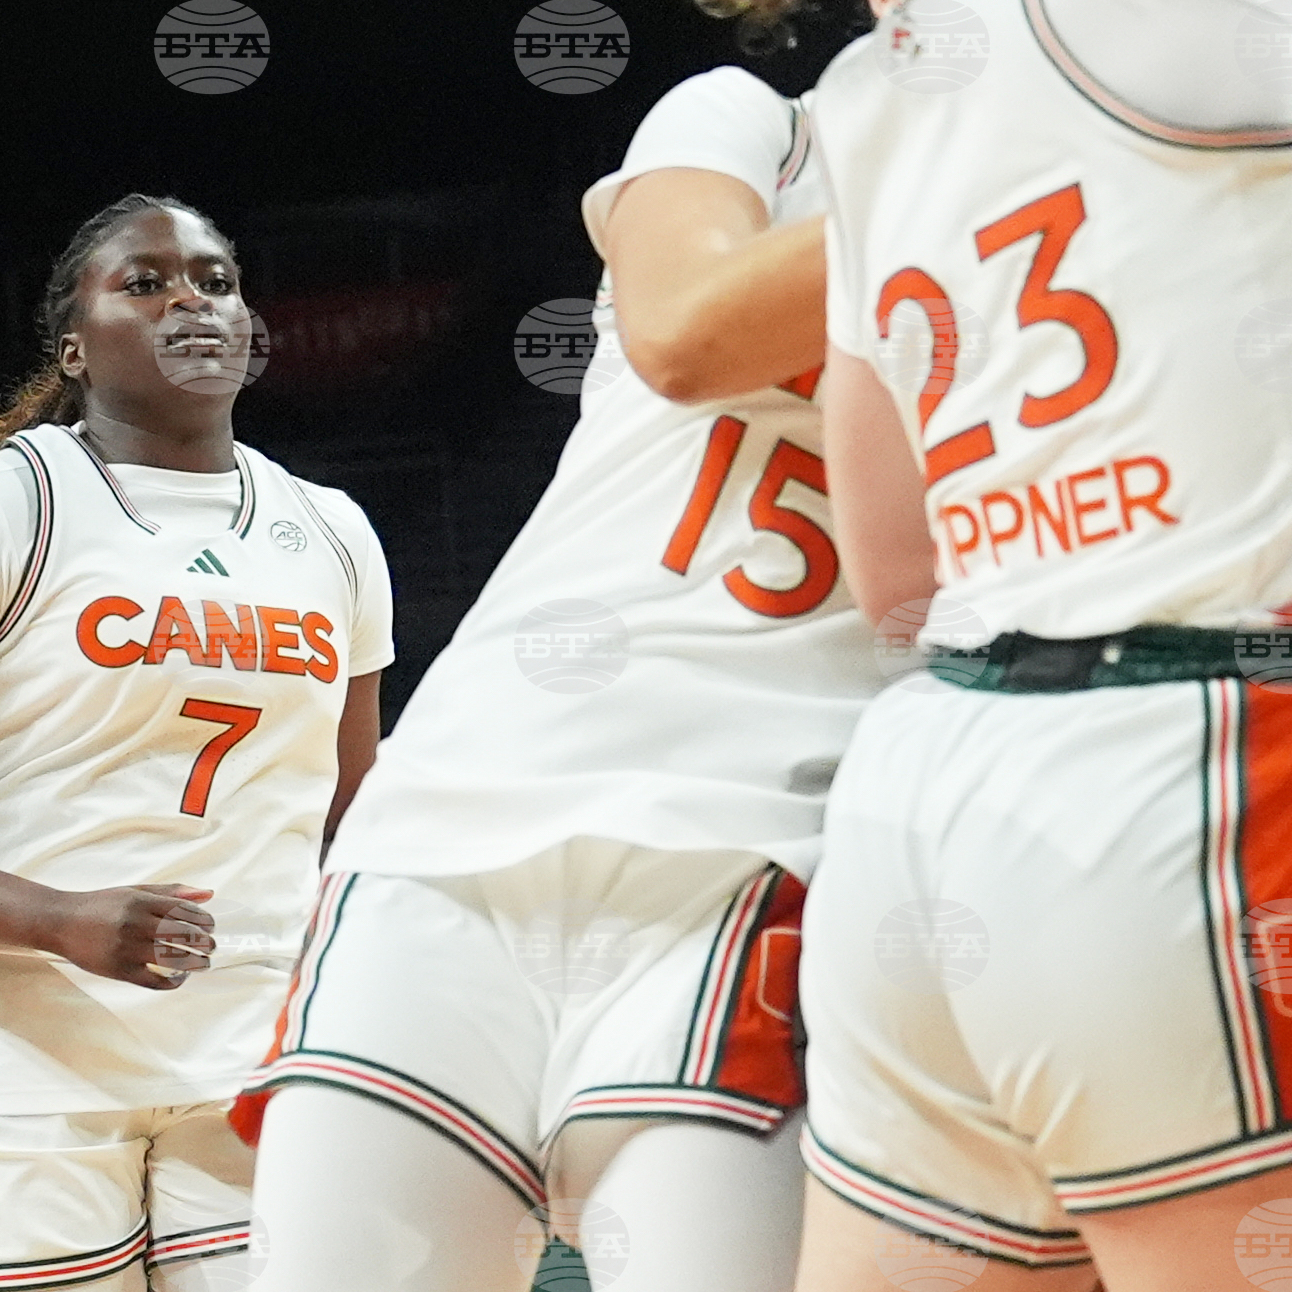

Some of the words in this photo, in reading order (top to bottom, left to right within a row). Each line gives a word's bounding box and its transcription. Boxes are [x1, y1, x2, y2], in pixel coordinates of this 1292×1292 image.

[876, 182, 1118, 487] 23
[660, 415, 840, 618] 15
[76, 596, 339, 684] CANES
[179, 697, 263, 817] 7
